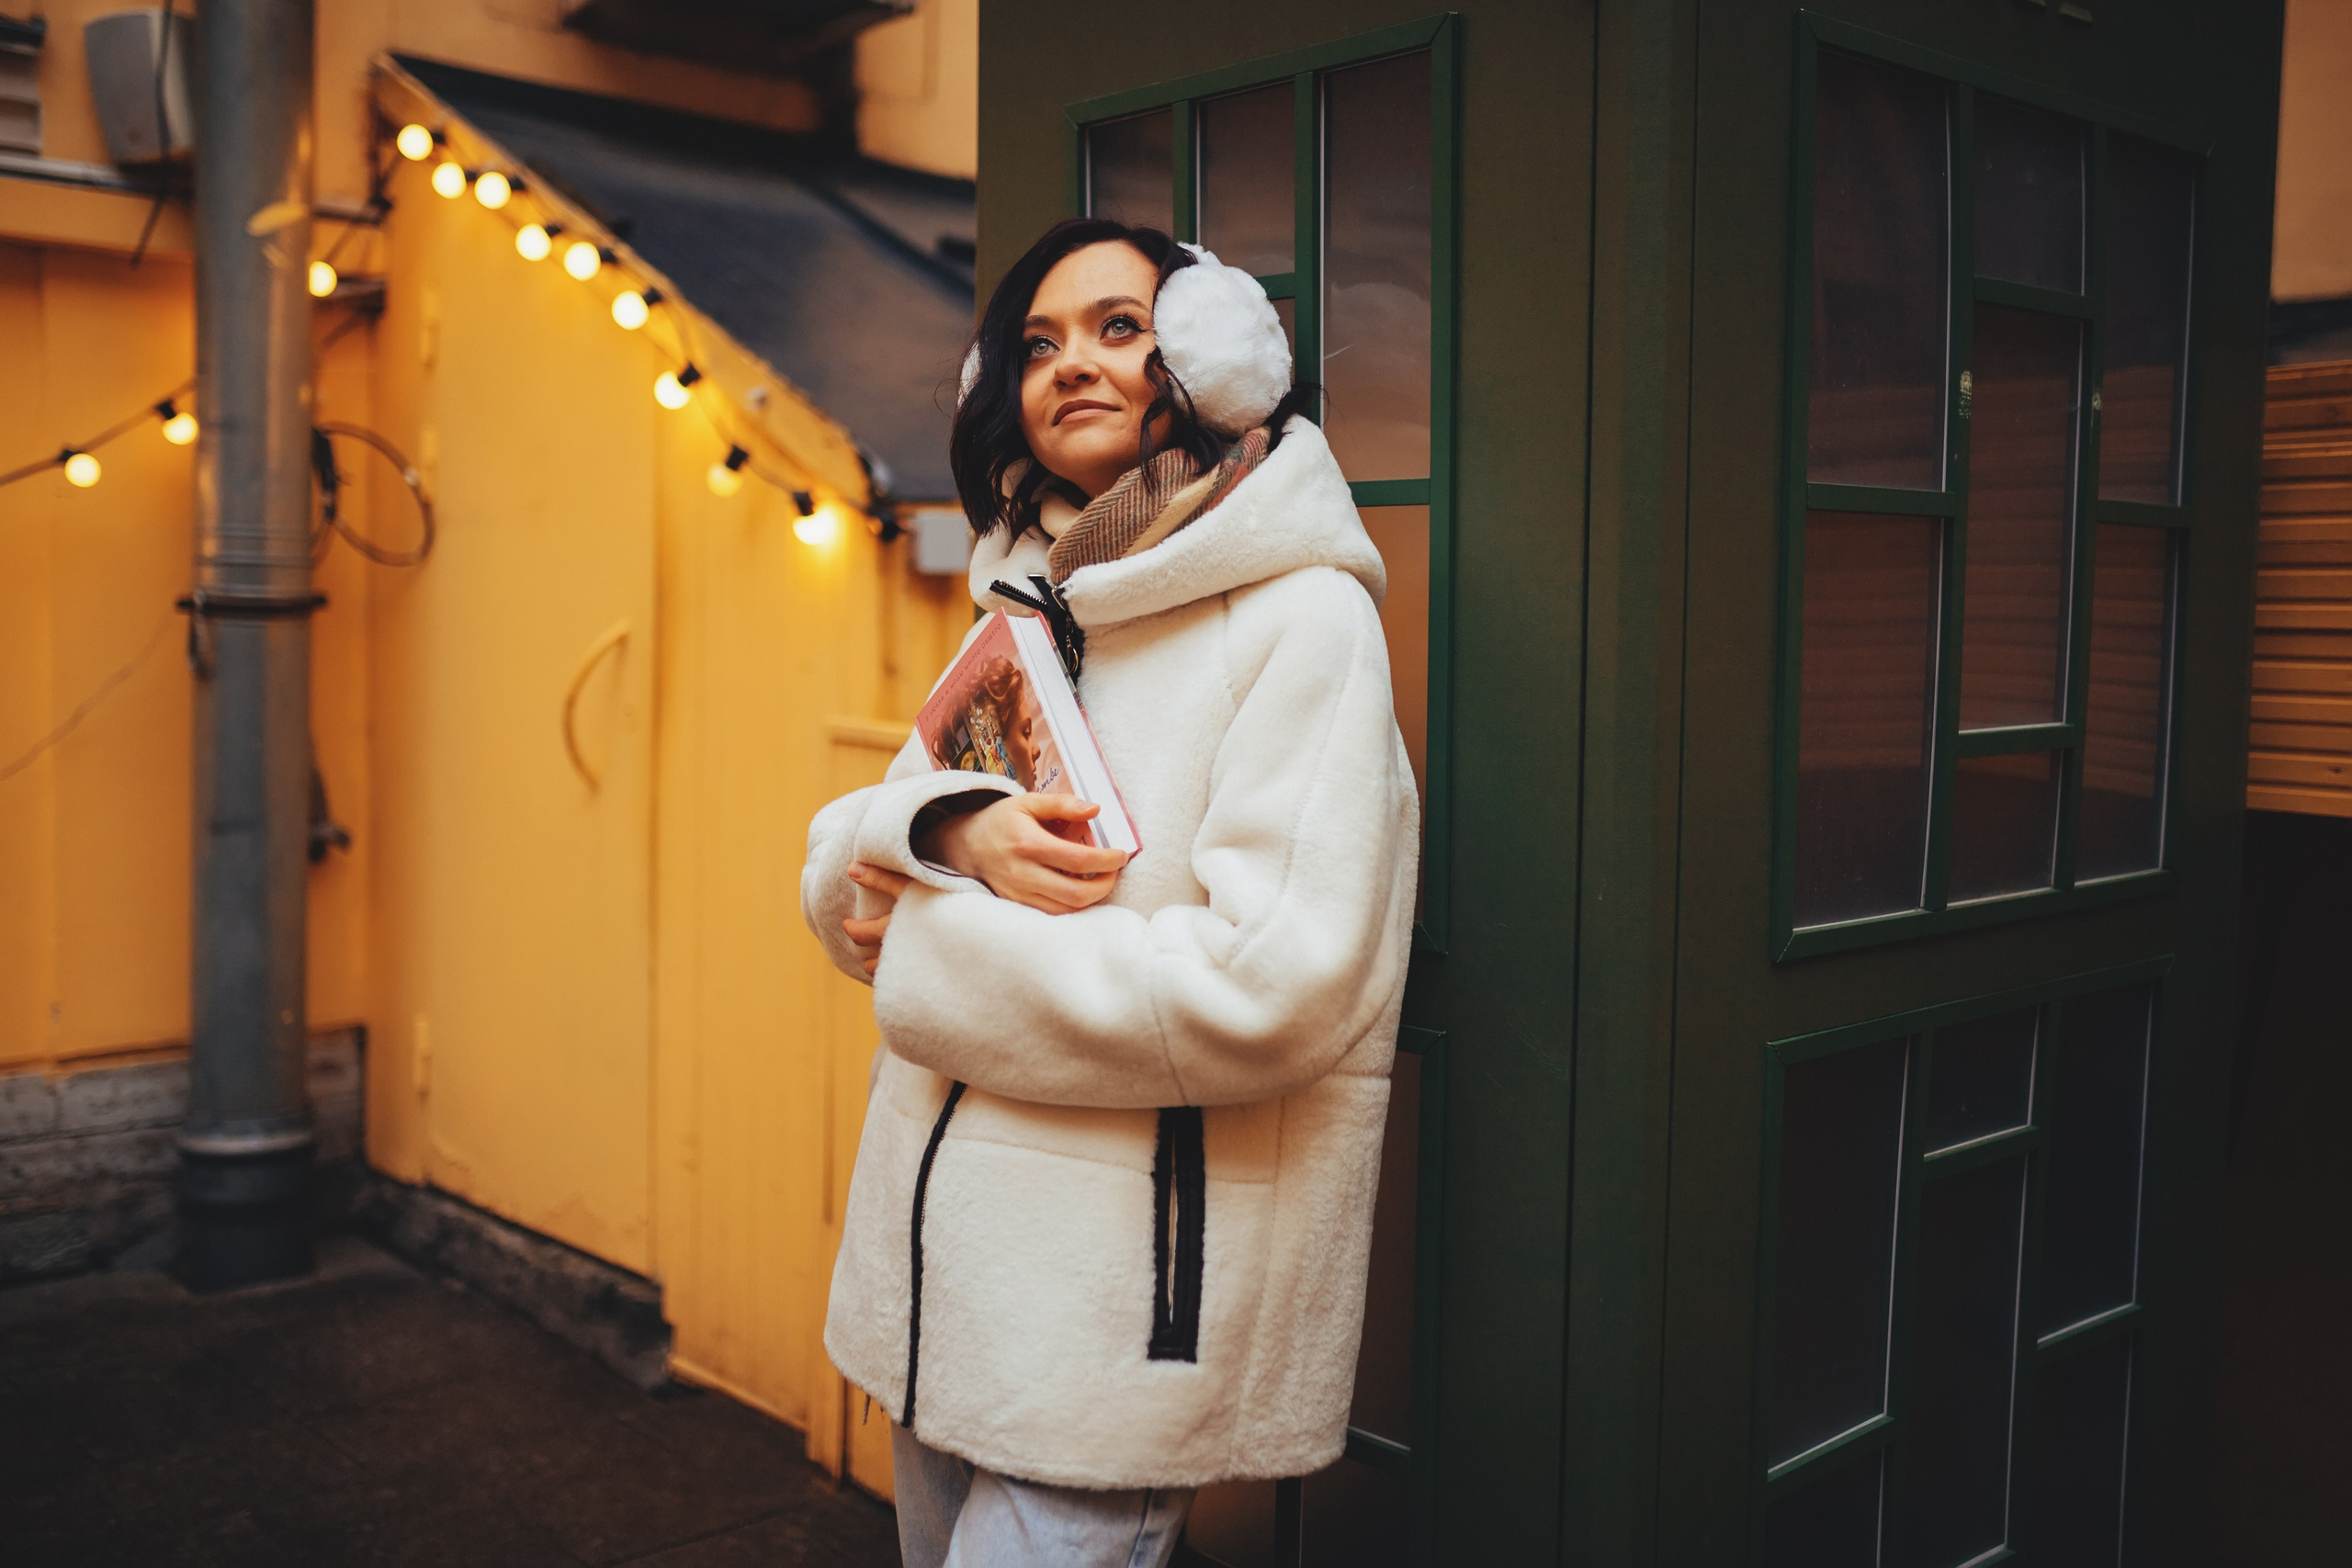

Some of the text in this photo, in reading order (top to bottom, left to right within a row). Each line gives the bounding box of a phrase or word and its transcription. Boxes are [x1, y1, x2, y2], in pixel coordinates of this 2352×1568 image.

[930, 695, 944, 716] ЛЮБВИ
[950, 670, 963, 689] МОДЫ
[964, 648, 980, 670] МНОГО
[982, 623, 1001, 649] ОБЩЕГО
